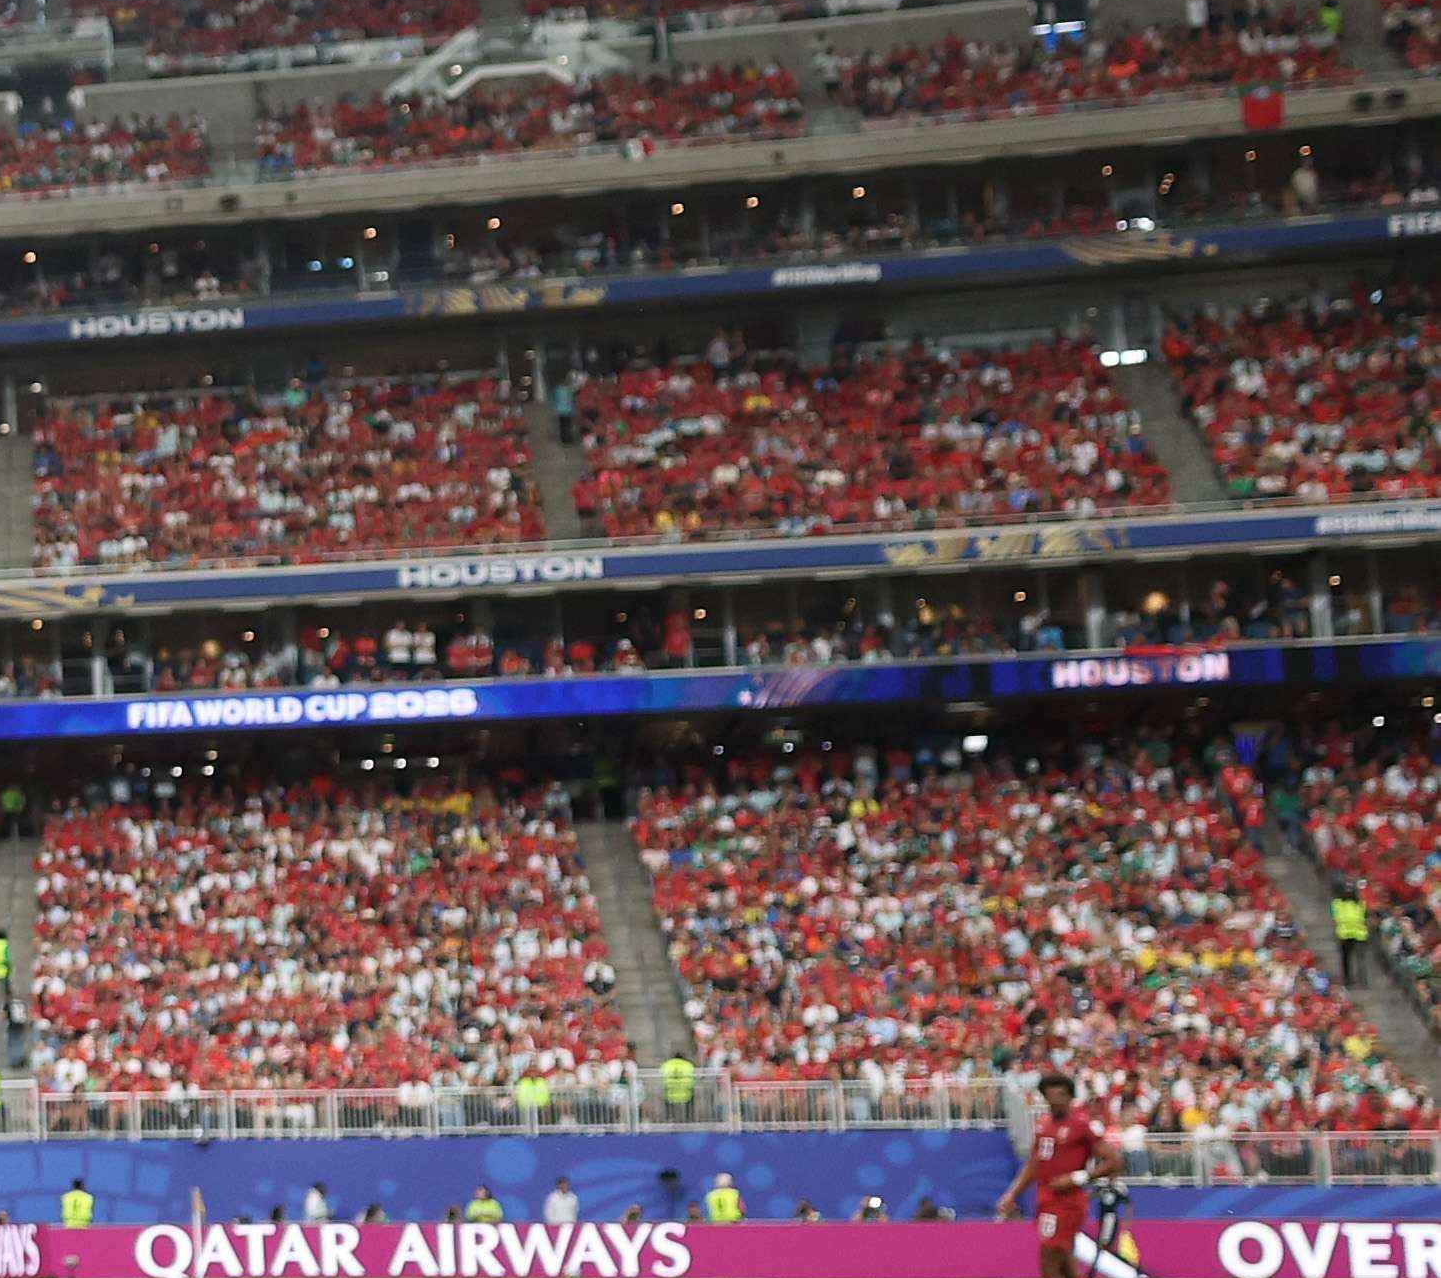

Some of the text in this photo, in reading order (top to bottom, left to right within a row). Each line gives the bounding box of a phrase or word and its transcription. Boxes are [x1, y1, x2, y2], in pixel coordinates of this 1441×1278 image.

[72, 308, 244, 339] HOUSTON
[399, 555, 604, 589] HOUSTON
[1051, 651, 1230, 688] HOUSTON
[127, 688, 478, 730] FIFA WORLD CUP 2026
[389, 1222, 692, 1278] AIRWAYS
